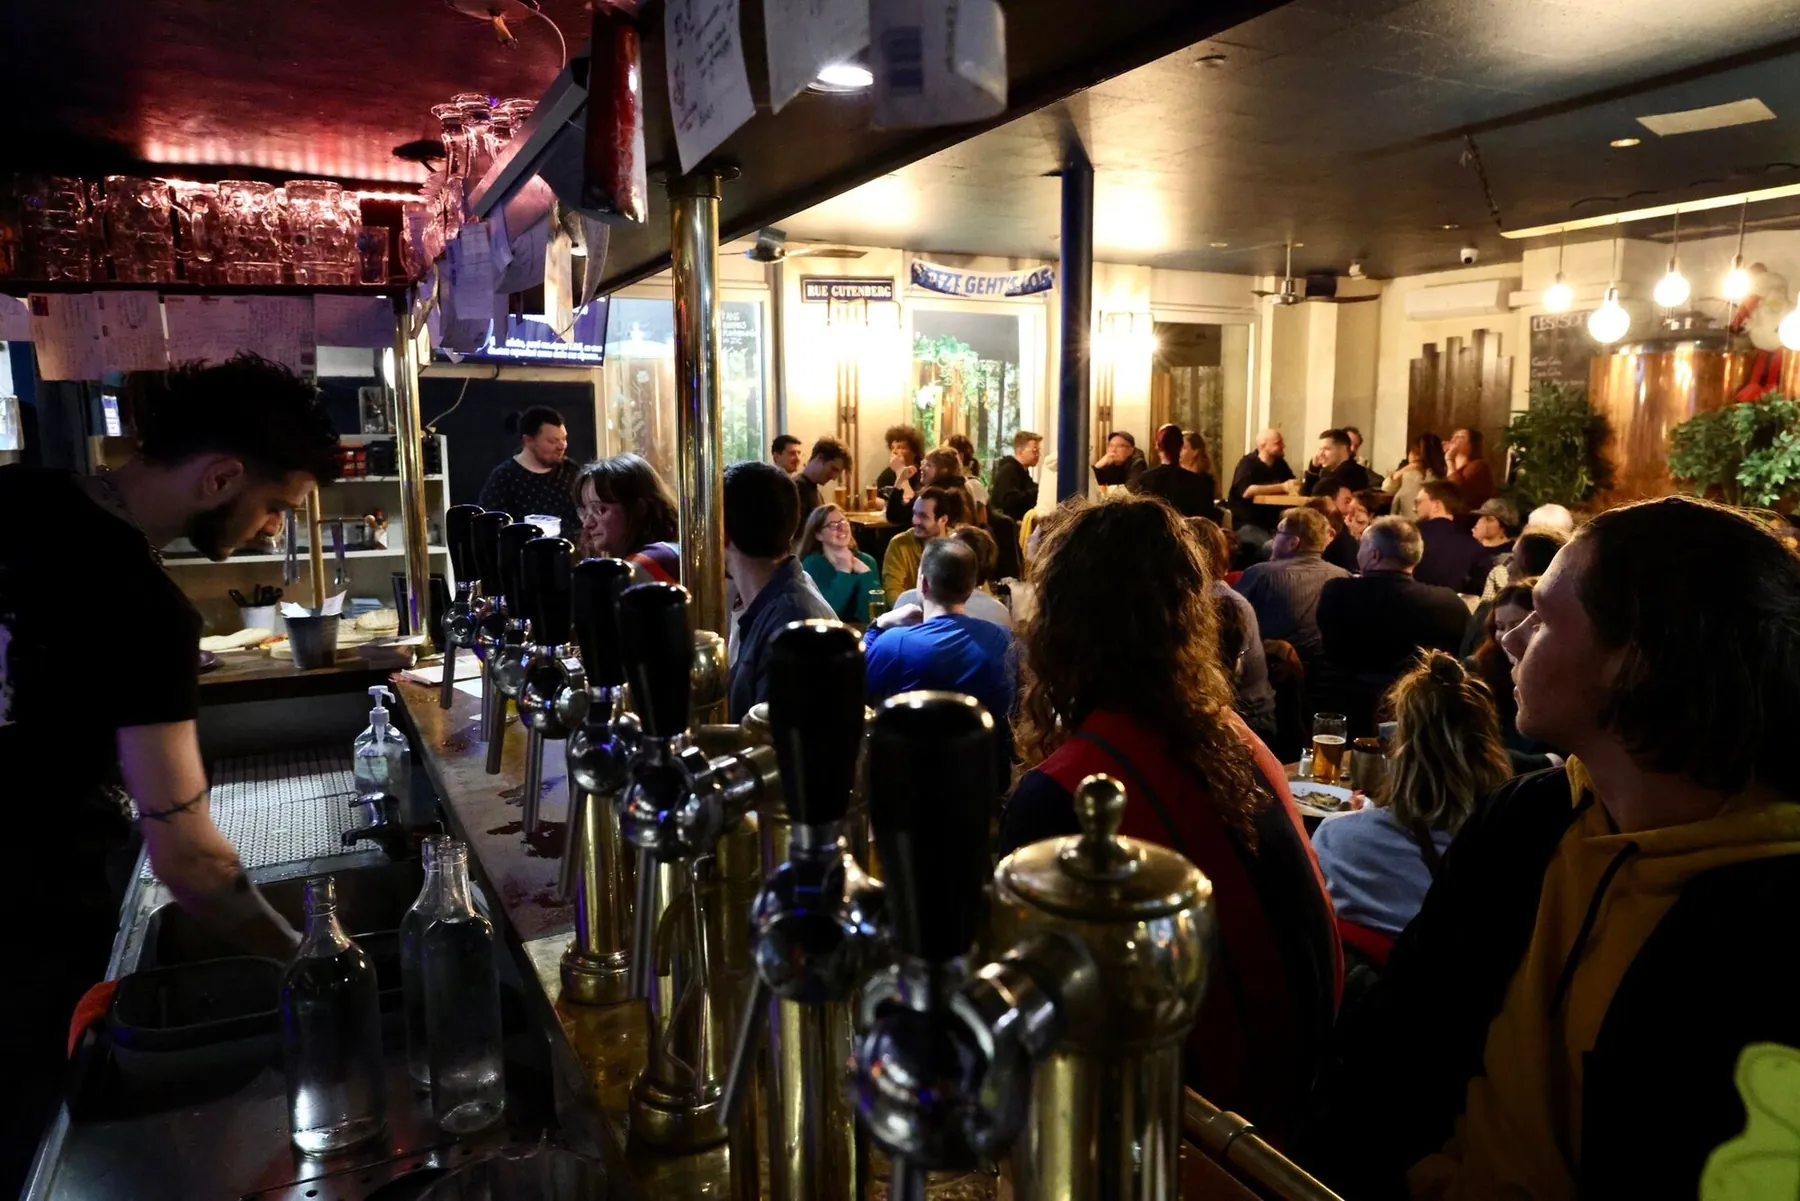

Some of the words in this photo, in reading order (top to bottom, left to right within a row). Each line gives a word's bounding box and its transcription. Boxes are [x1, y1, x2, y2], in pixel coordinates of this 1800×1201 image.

[807, 284, 829, 297] RUE
[831, 285, 892, 298] GUTENBERG
[1532, 317, 1555, 332] LES
